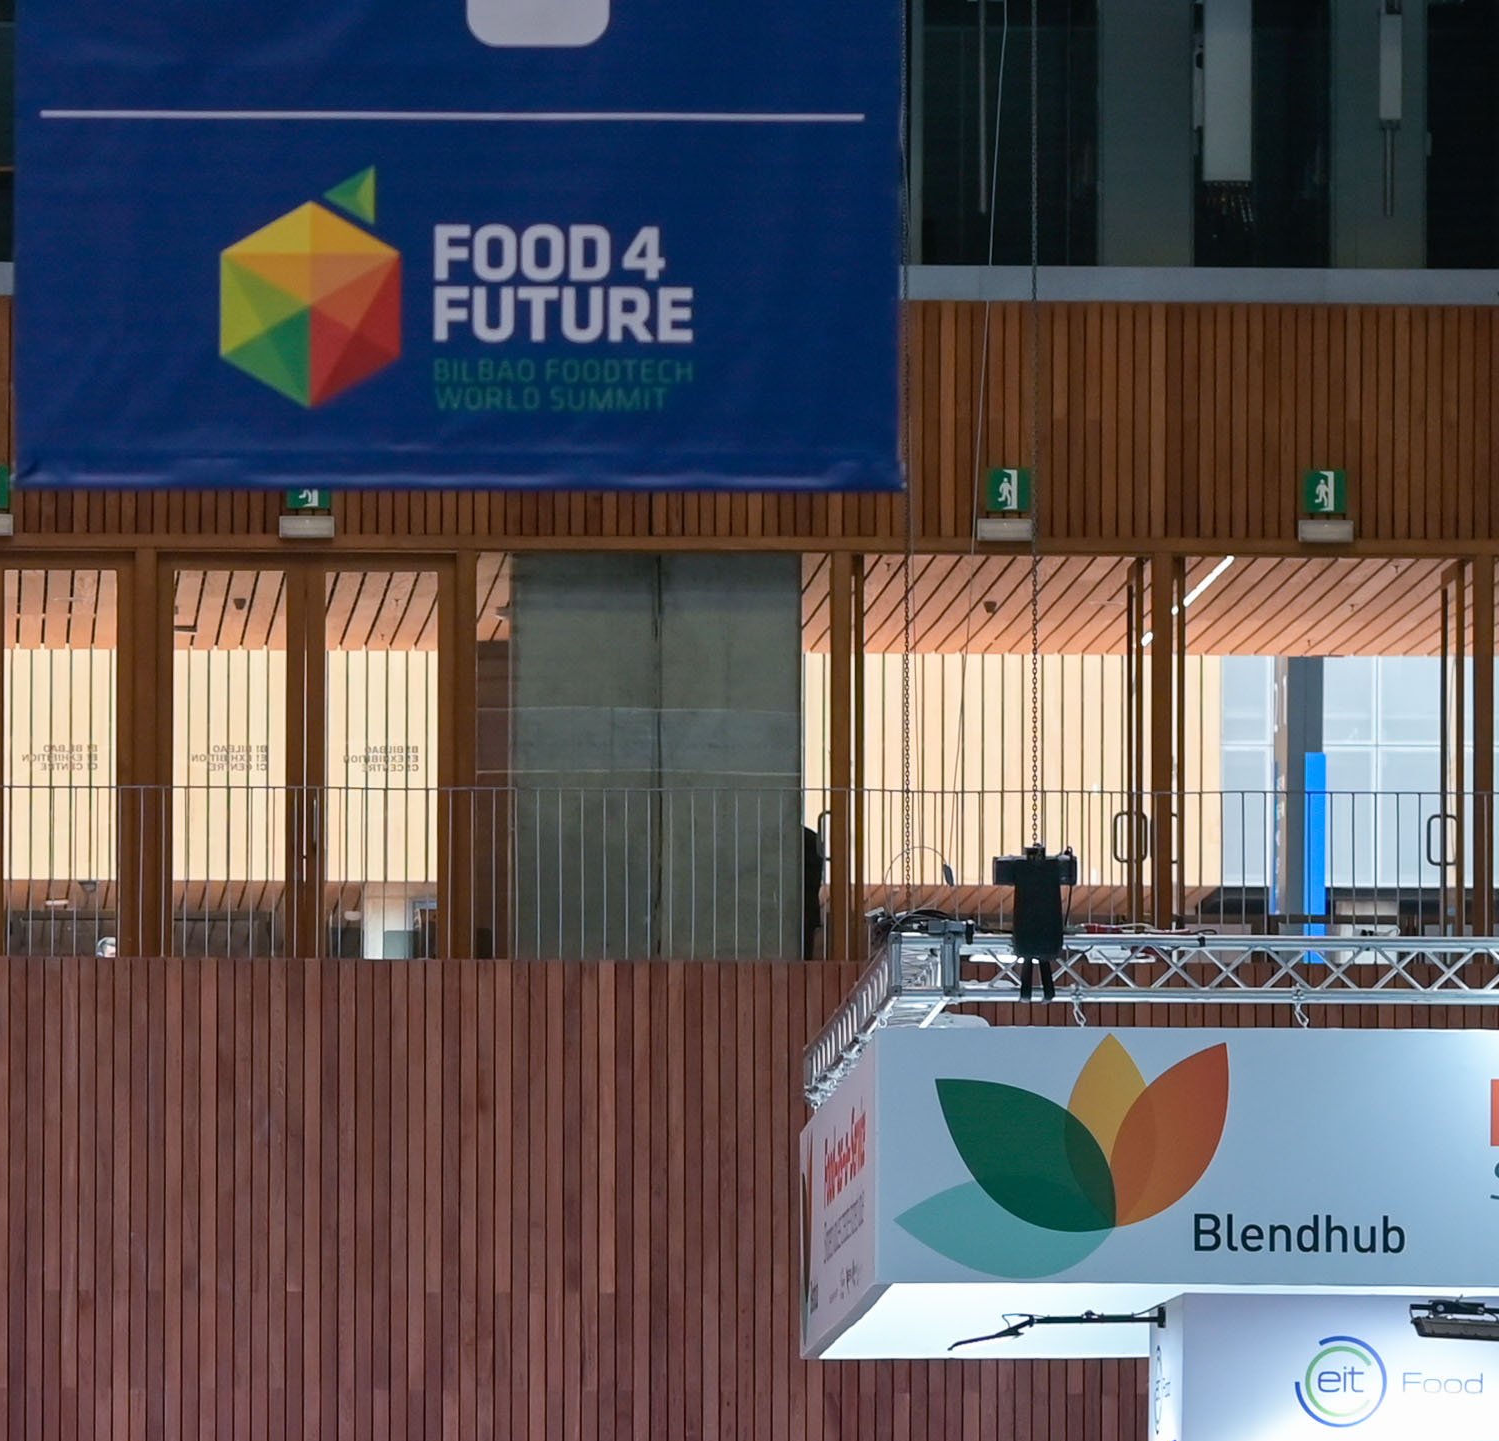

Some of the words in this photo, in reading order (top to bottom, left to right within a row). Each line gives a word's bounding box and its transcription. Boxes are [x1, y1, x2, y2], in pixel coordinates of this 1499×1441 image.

[434, 224, 611, 282] FOOD
[622, 226, 666, 281] 4
[433, 286, 693, 343] FUTURE
[433, 358, 535, 382] BILBAO
[545, 359, 693, 383] FOODTECH
[435, 386, 540, 410] WORLD
[549, 387, 667, 411] SUMMIT
[1192, 1212, 1405, 1255] Blendhub
[1317, 1366, 1364, 1393] eit
[1402, 1372, 1483, 1394] Food
